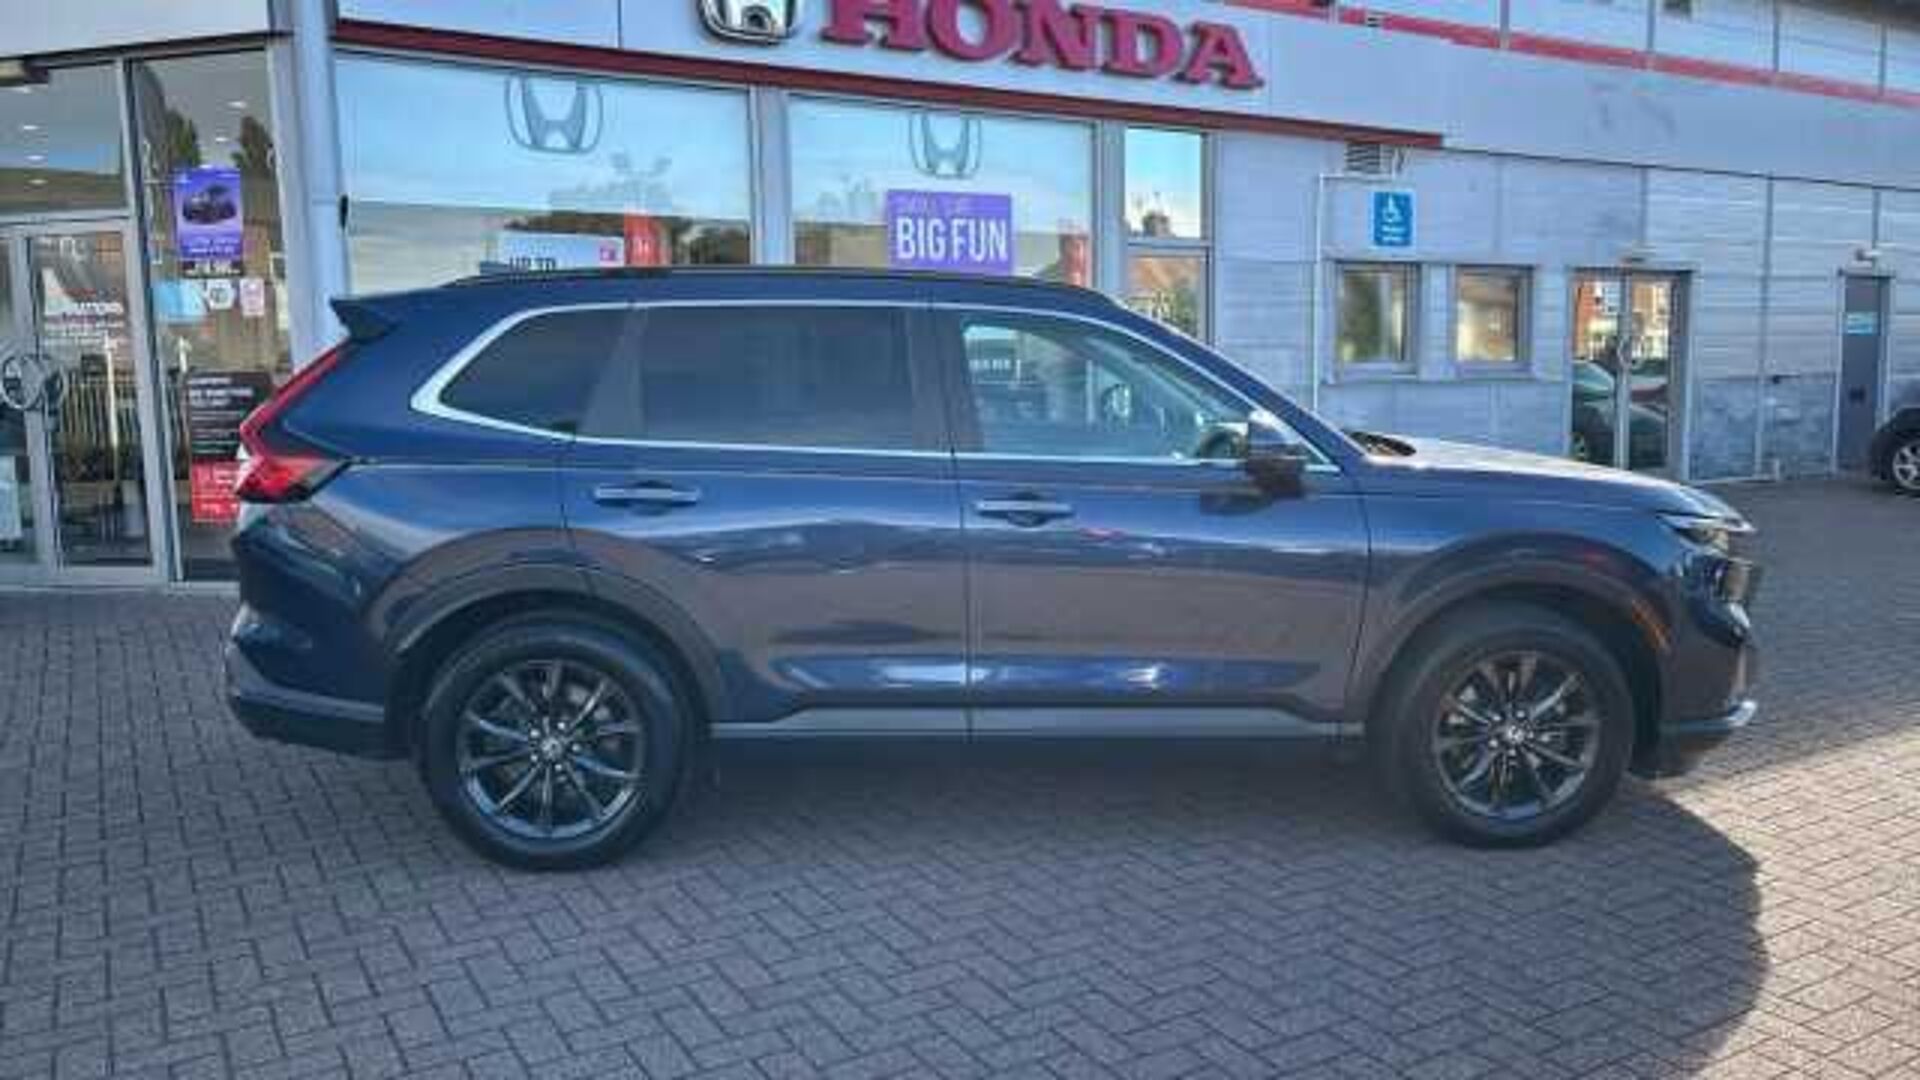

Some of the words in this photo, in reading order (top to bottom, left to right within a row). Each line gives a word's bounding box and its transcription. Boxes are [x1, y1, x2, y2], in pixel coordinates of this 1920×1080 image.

[821, 0, 1263, 88] HONDA
[896, 216, 946, 260] BIG
[951, 217, 1008, 262] FUN
